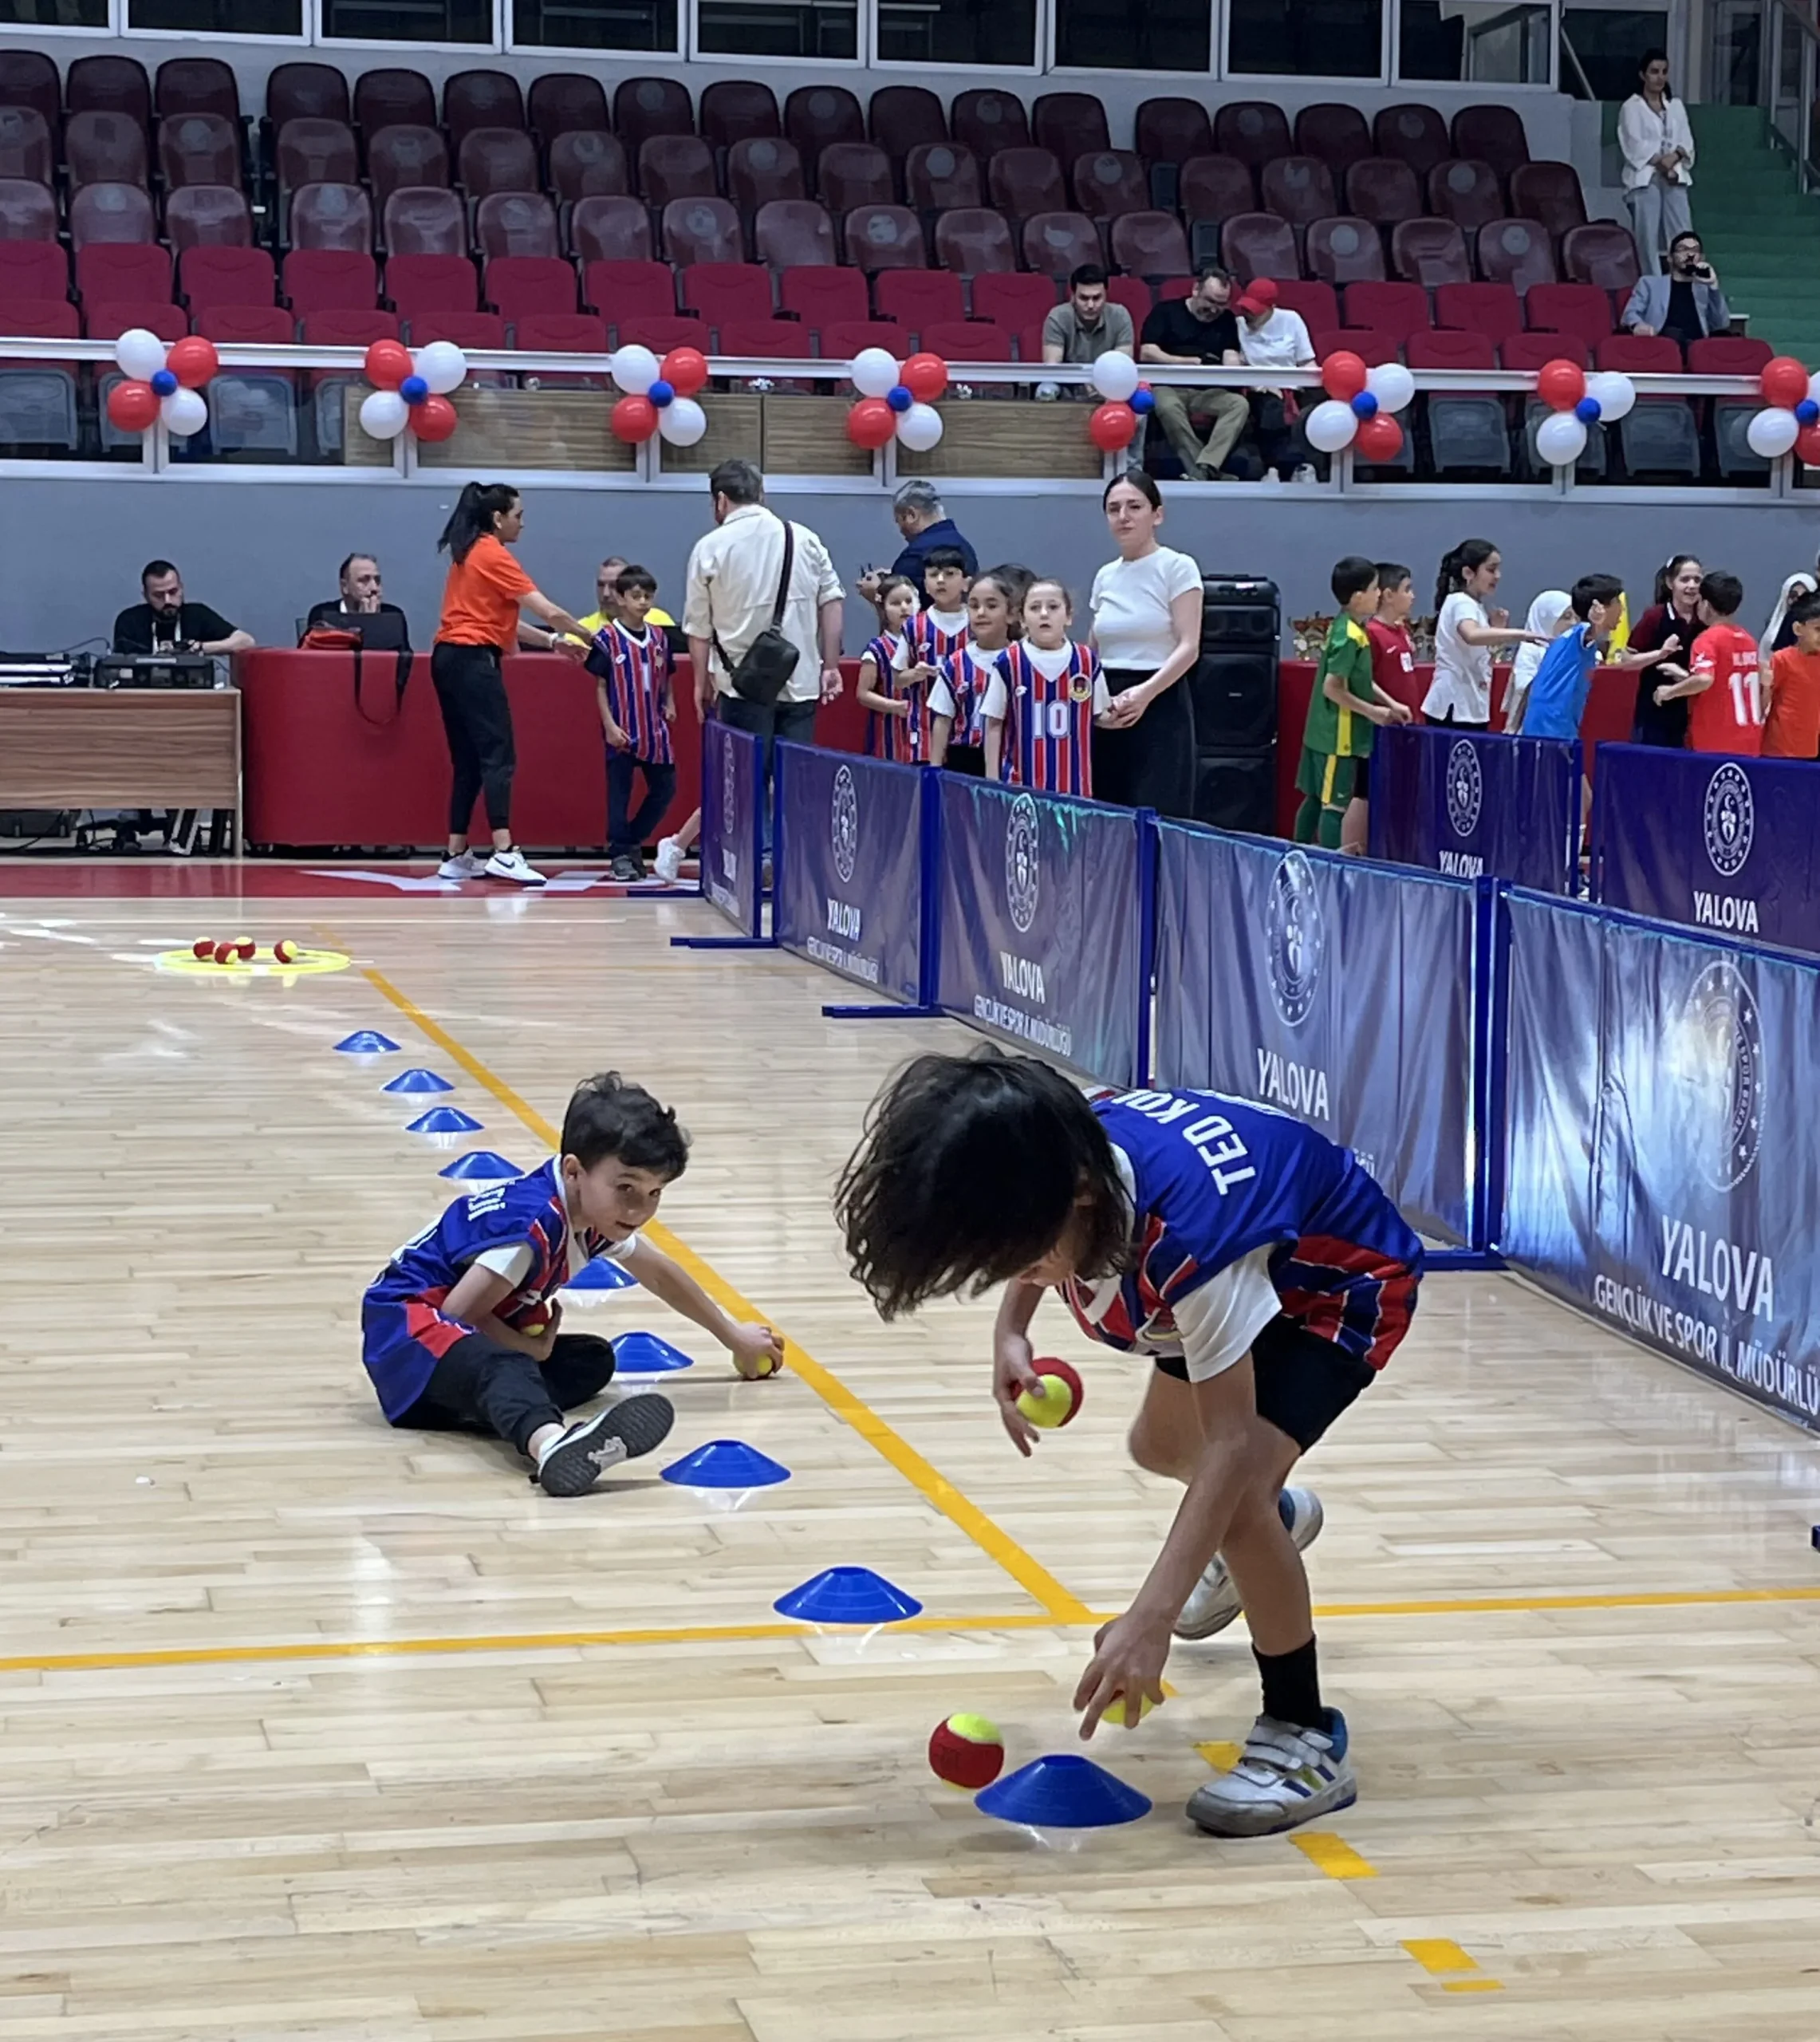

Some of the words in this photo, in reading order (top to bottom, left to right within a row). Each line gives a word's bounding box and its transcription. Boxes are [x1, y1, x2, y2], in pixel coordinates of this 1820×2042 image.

[1032, 701, 1070, 738] 10
[1693, 890, 1759, 933] YALOVA
[999, 951, 1046, 1004] YALOVA
[1257, 1047, 1330, 1122] YALOVA
[1182, 1115, 1256, 1196] TED
[1661, 1214, 1774, 1323] YALOVA
[1595, 1274, 1656, 1335] GENÇLİK
[1653, 1300, 1675, 1345] VE
[1675, 1311, 1717, 1366] SPOR
